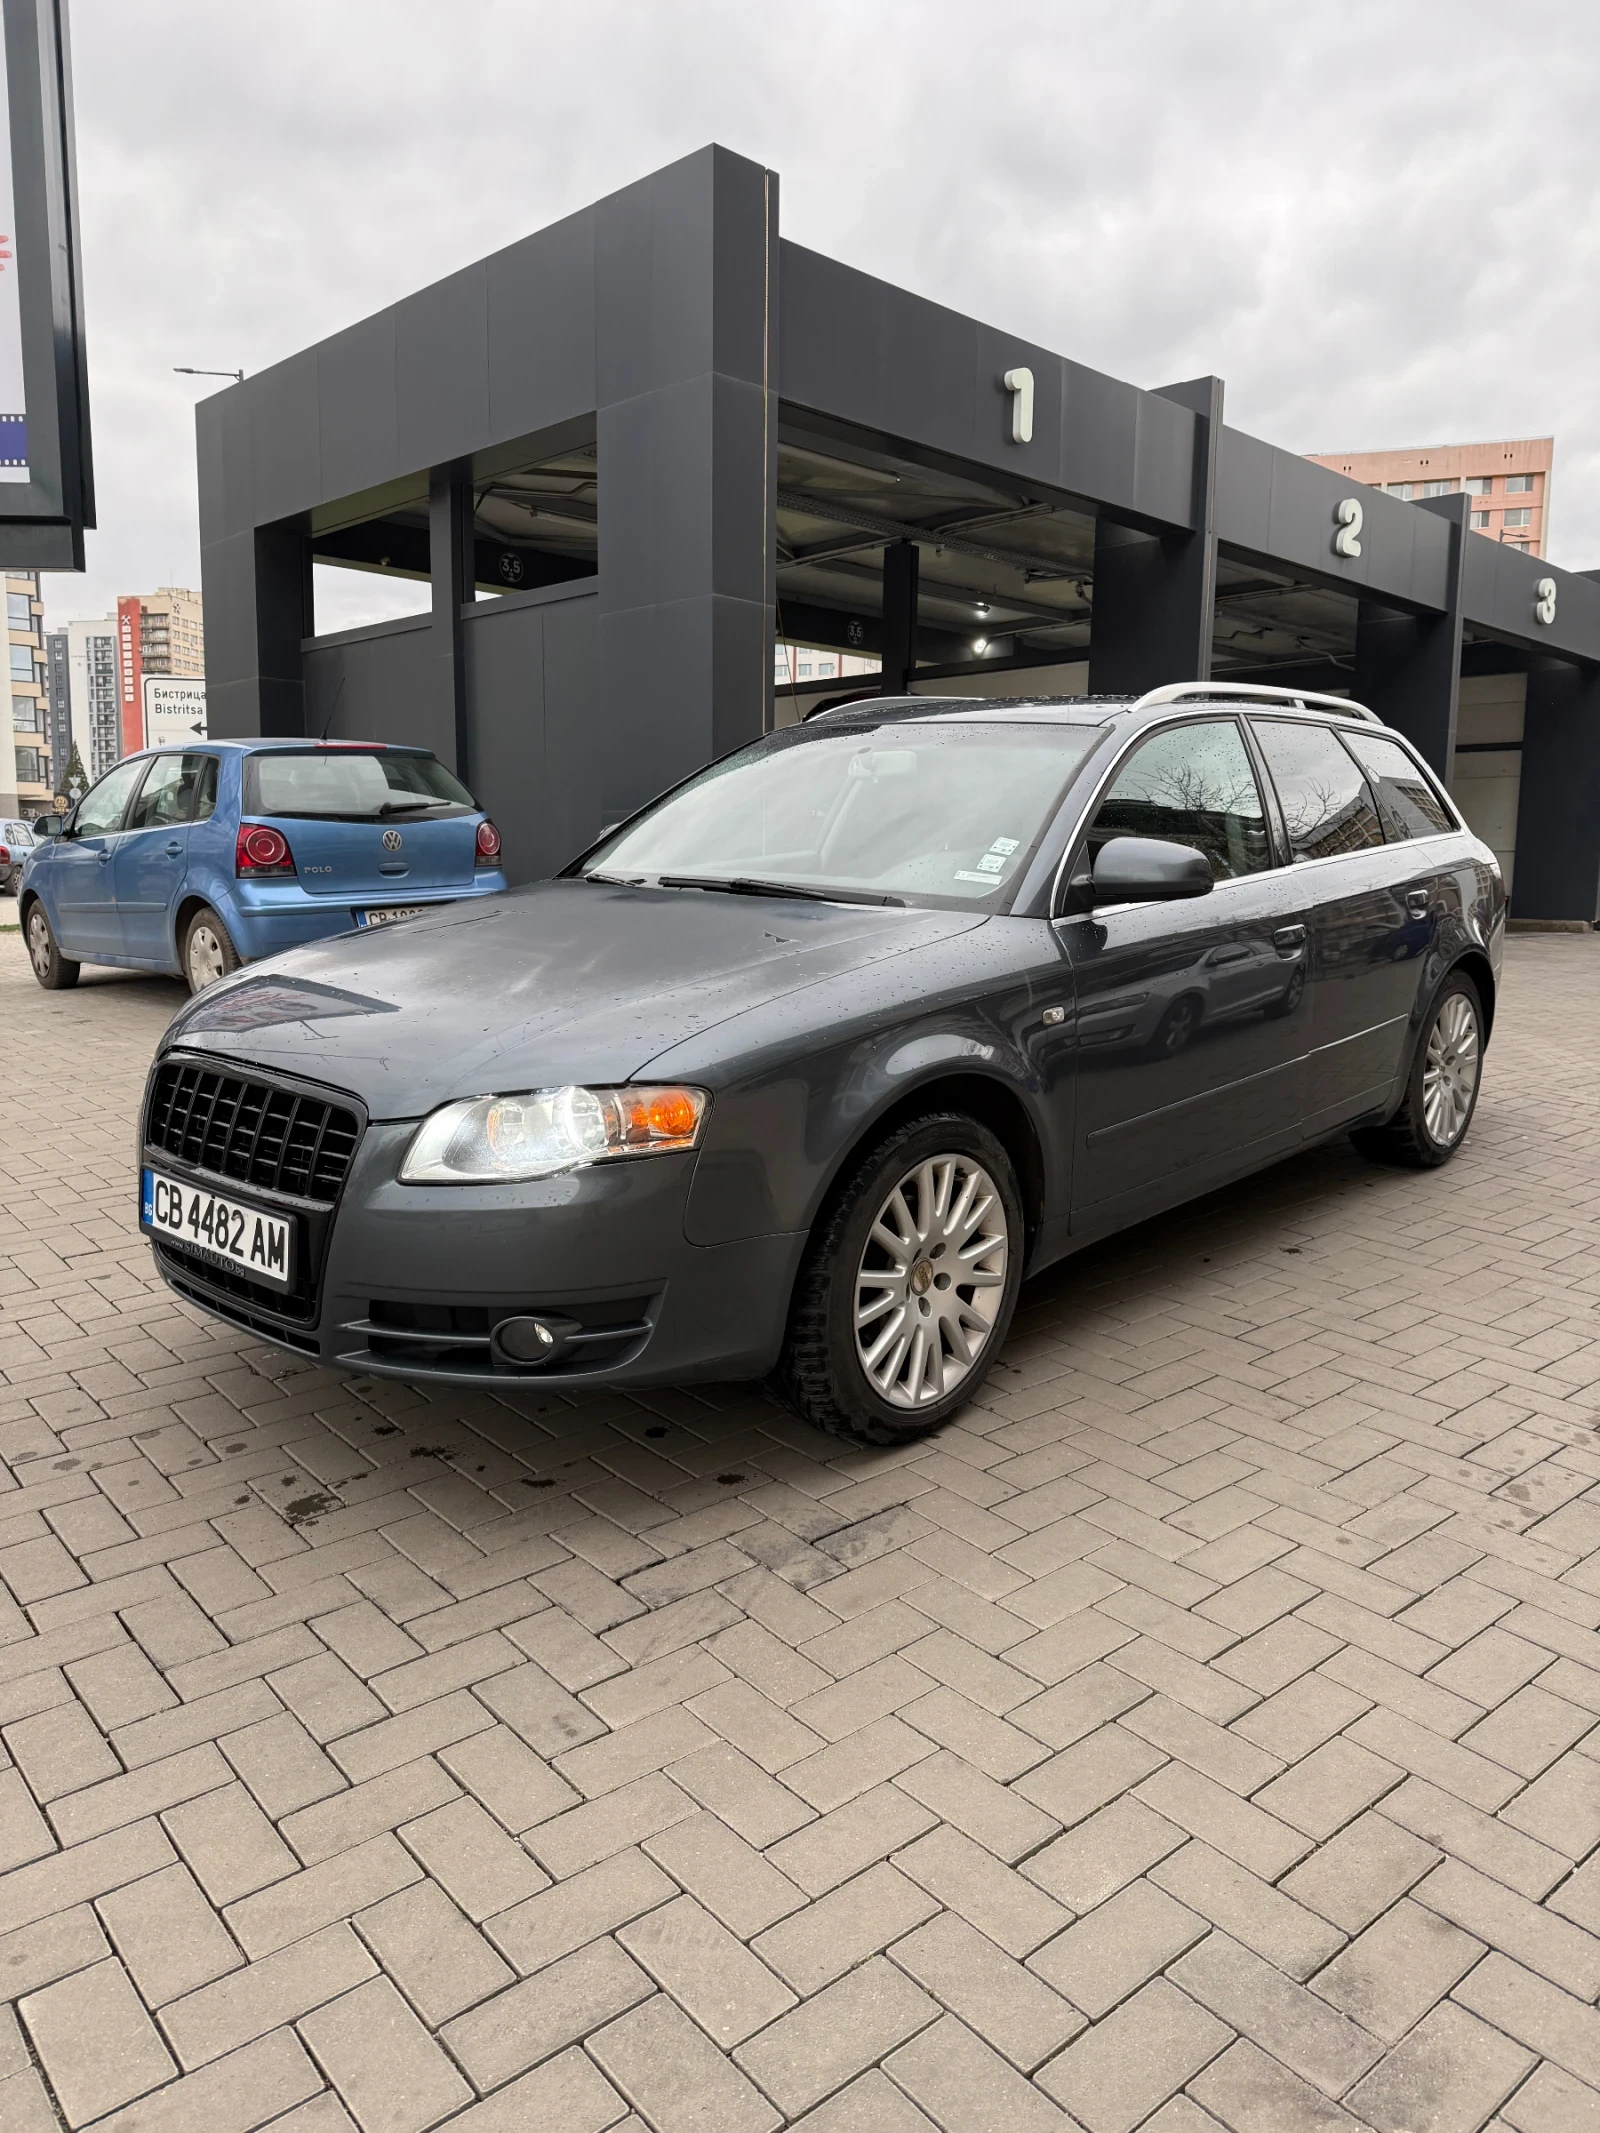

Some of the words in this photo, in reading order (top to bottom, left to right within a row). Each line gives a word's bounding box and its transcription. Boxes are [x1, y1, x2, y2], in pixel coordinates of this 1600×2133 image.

[1004, 367, 1034, 443] 1
[1336, 498, 1363, 557] 2
[502, 558, 521, 574] 3.5
[1537, 577, 1557, 625] 3
[849, 625, 862, 638] 3.5
[154, 688, 206, 701] Бистрица
[155, 703, 203, 715] Bistritsa
[304, 865, 332, 874] POLO
[144, 1203, 153, 1216] BG
[155, 1180, 183, 1230] CB
[187, 1194, 245, 1258] 4482
[250, 1217, 285, 1274] AM
